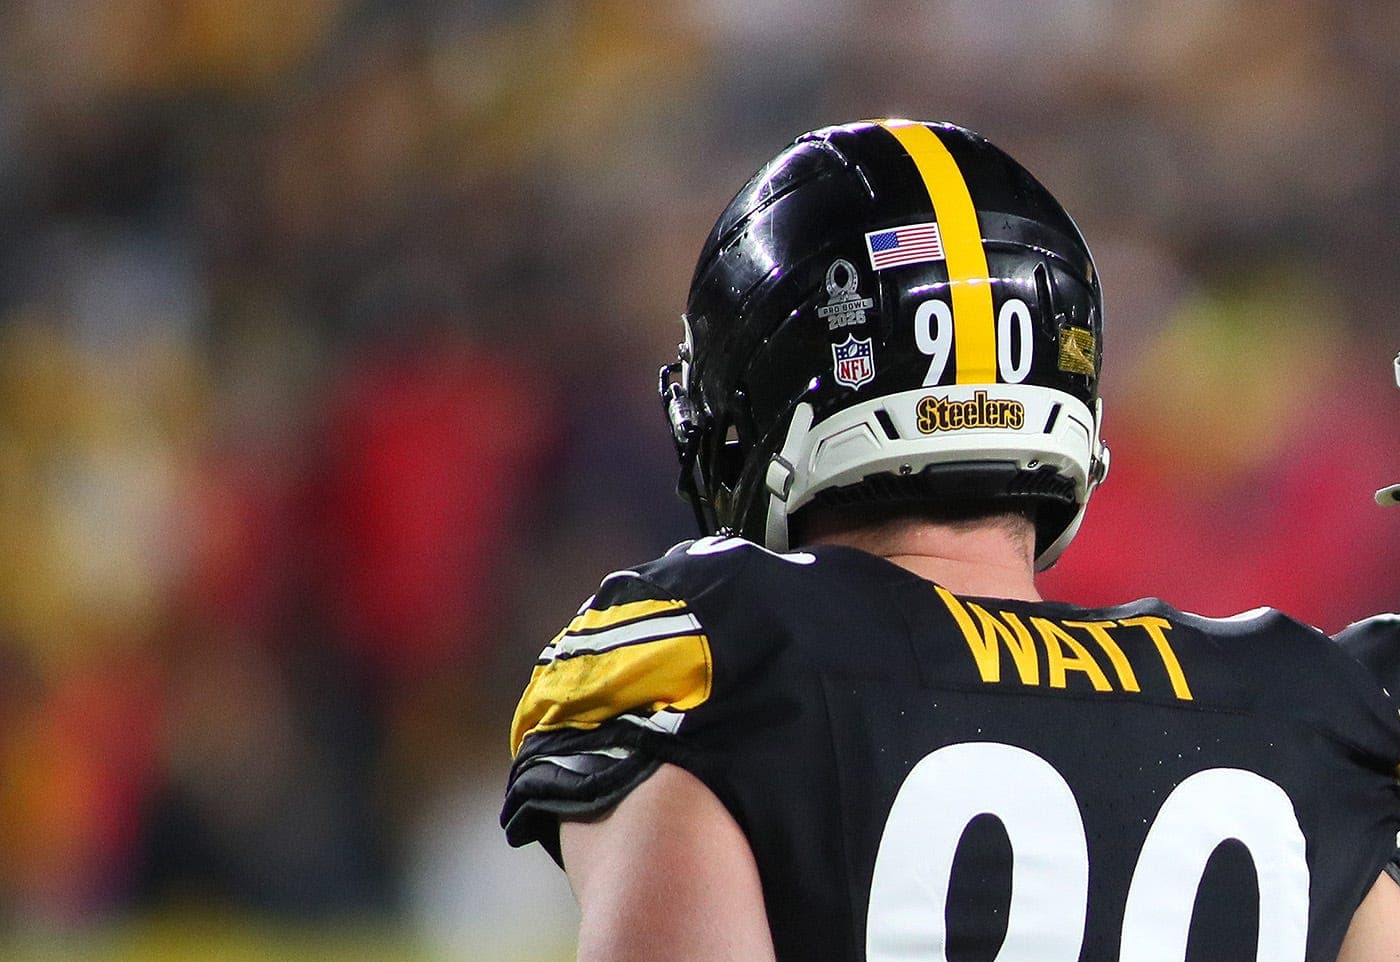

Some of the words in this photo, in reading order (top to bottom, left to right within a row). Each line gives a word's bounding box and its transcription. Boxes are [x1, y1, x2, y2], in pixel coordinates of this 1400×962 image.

[840, 358, 870, 381] NFL
[916, 390, 1025, 434] Steelers
[934, 585, 1194, 701] WATT
